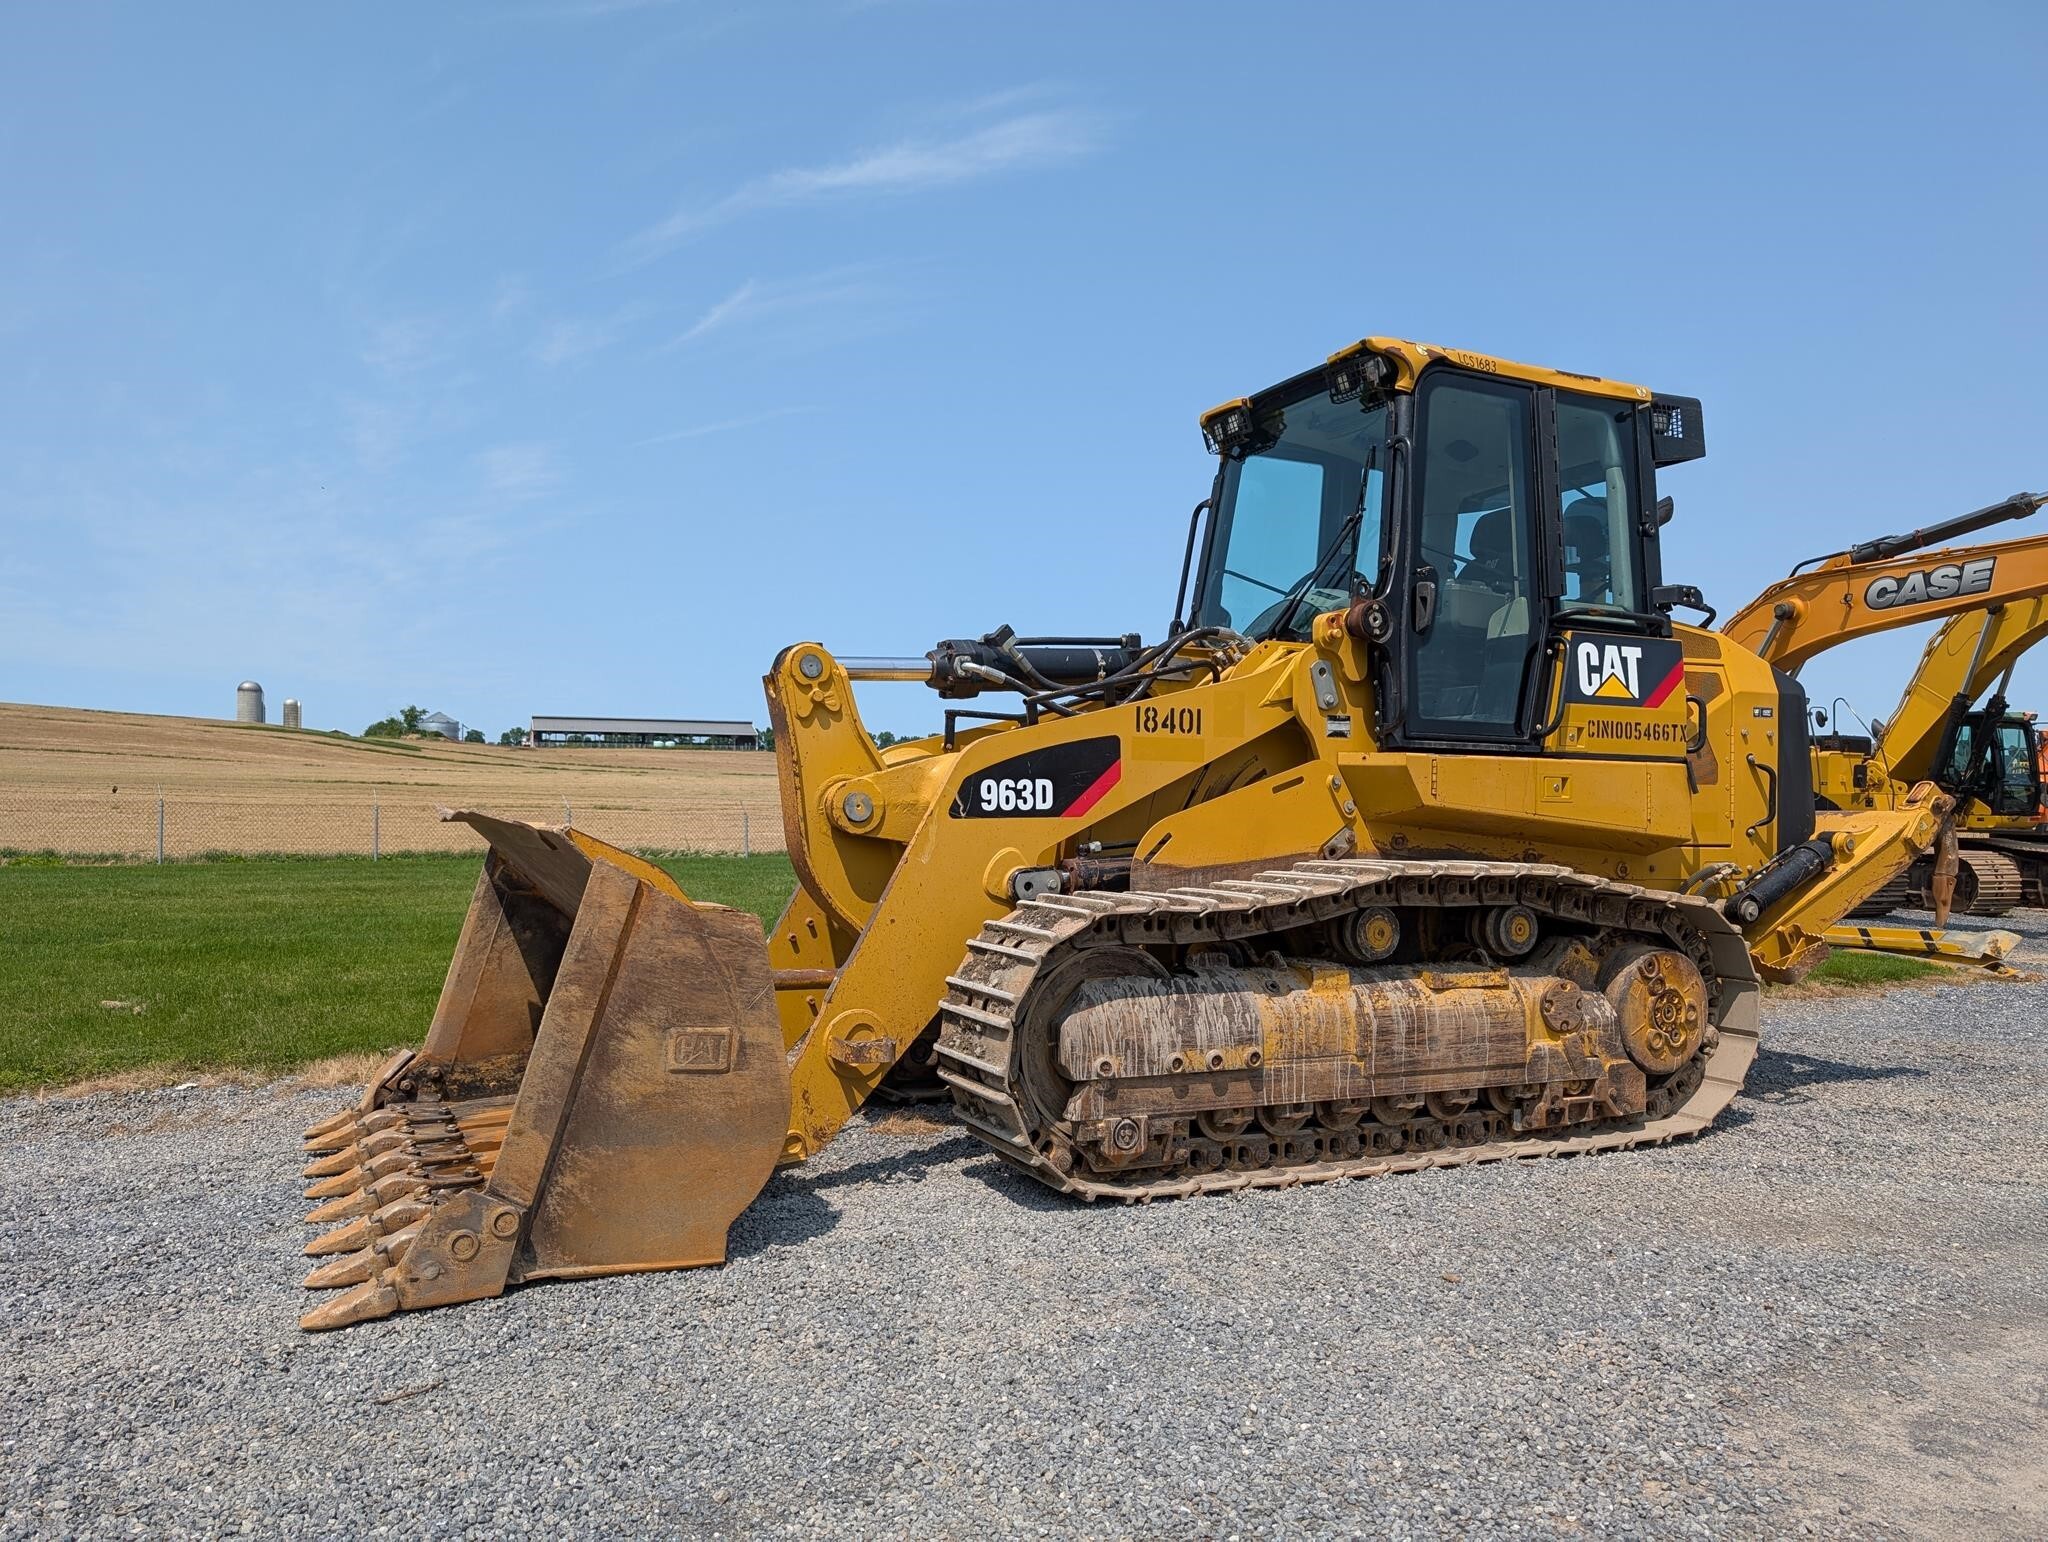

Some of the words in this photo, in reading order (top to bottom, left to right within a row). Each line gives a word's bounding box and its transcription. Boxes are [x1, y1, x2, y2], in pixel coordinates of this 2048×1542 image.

[1457, 352, 1497, 373] LCS1683
[1865, 557, 1996, 610] CASE
[1577, 642, 1642, 699] CAT
[1135, 706, 1202, 735] 18401
[980, 778, 1053, 811] 963D
